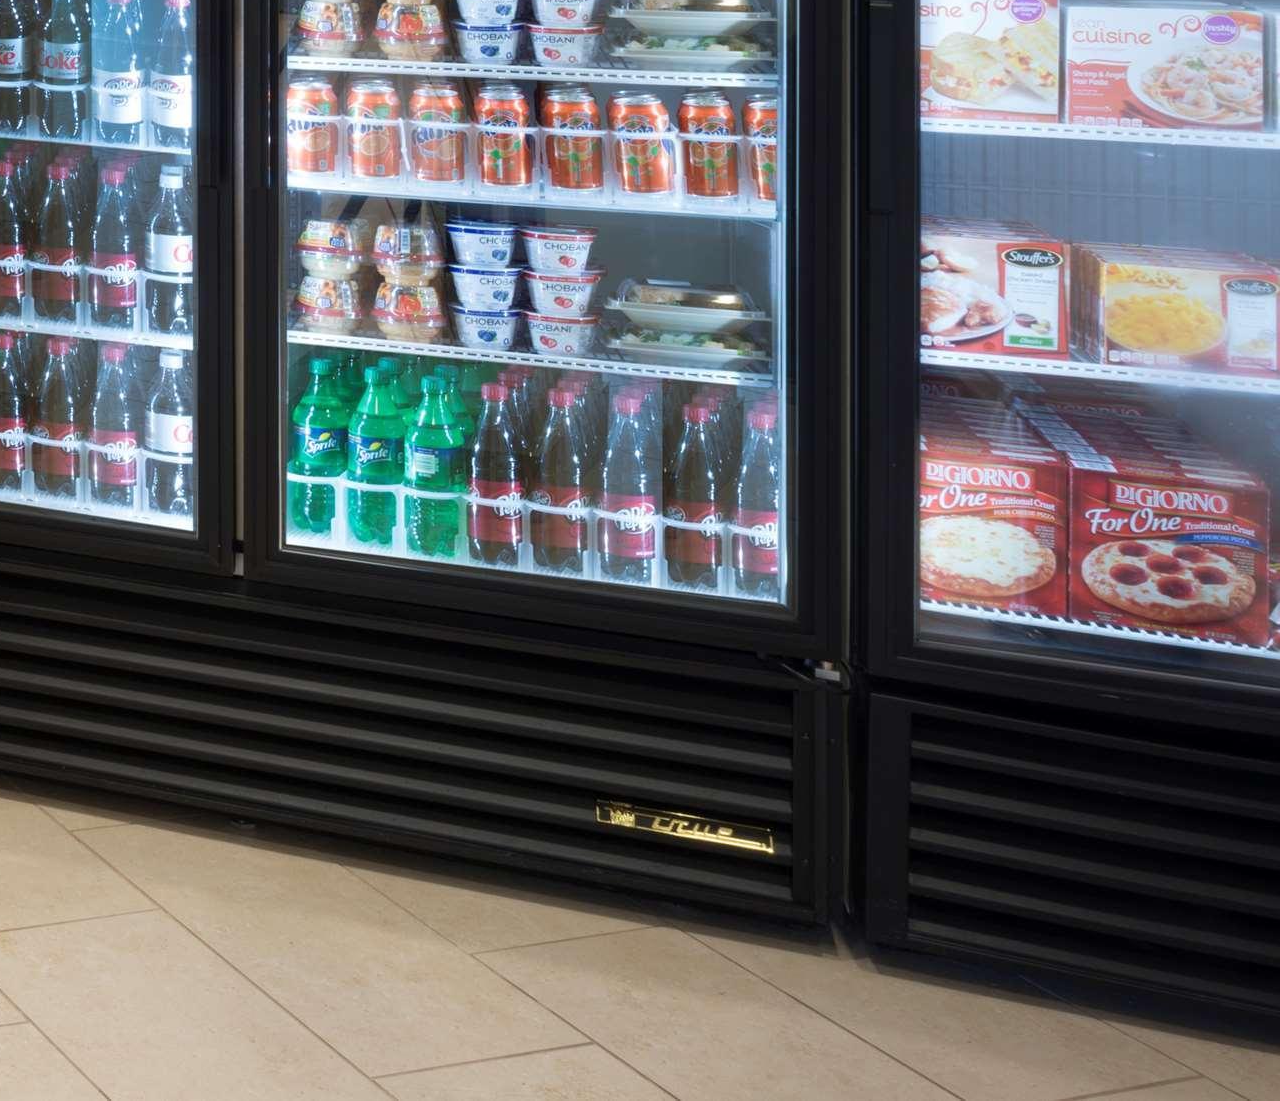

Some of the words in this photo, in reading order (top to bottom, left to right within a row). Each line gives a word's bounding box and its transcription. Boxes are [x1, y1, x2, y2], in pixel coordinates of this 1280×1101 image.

[1072, 28, 1153, 46] cuisine
[1008, 249, 1056, 267] Stouffer's
[1224, 278, 1272, 295] Stouffer's
[305, 433, 340, 456] Sprite
[358, 443, 391, 466] Sprite
[938, 484, 988, 510] One
[990, 497, 1034, 509] Traditional
[1033, 499, 1056, 512] Crust
[1085, 507, 1129, 534] For
[1129, 506, 1181, 533] One
[1185, 521, 1232, 533] Traditional
[1231, 523, 1256, 537] Crust
